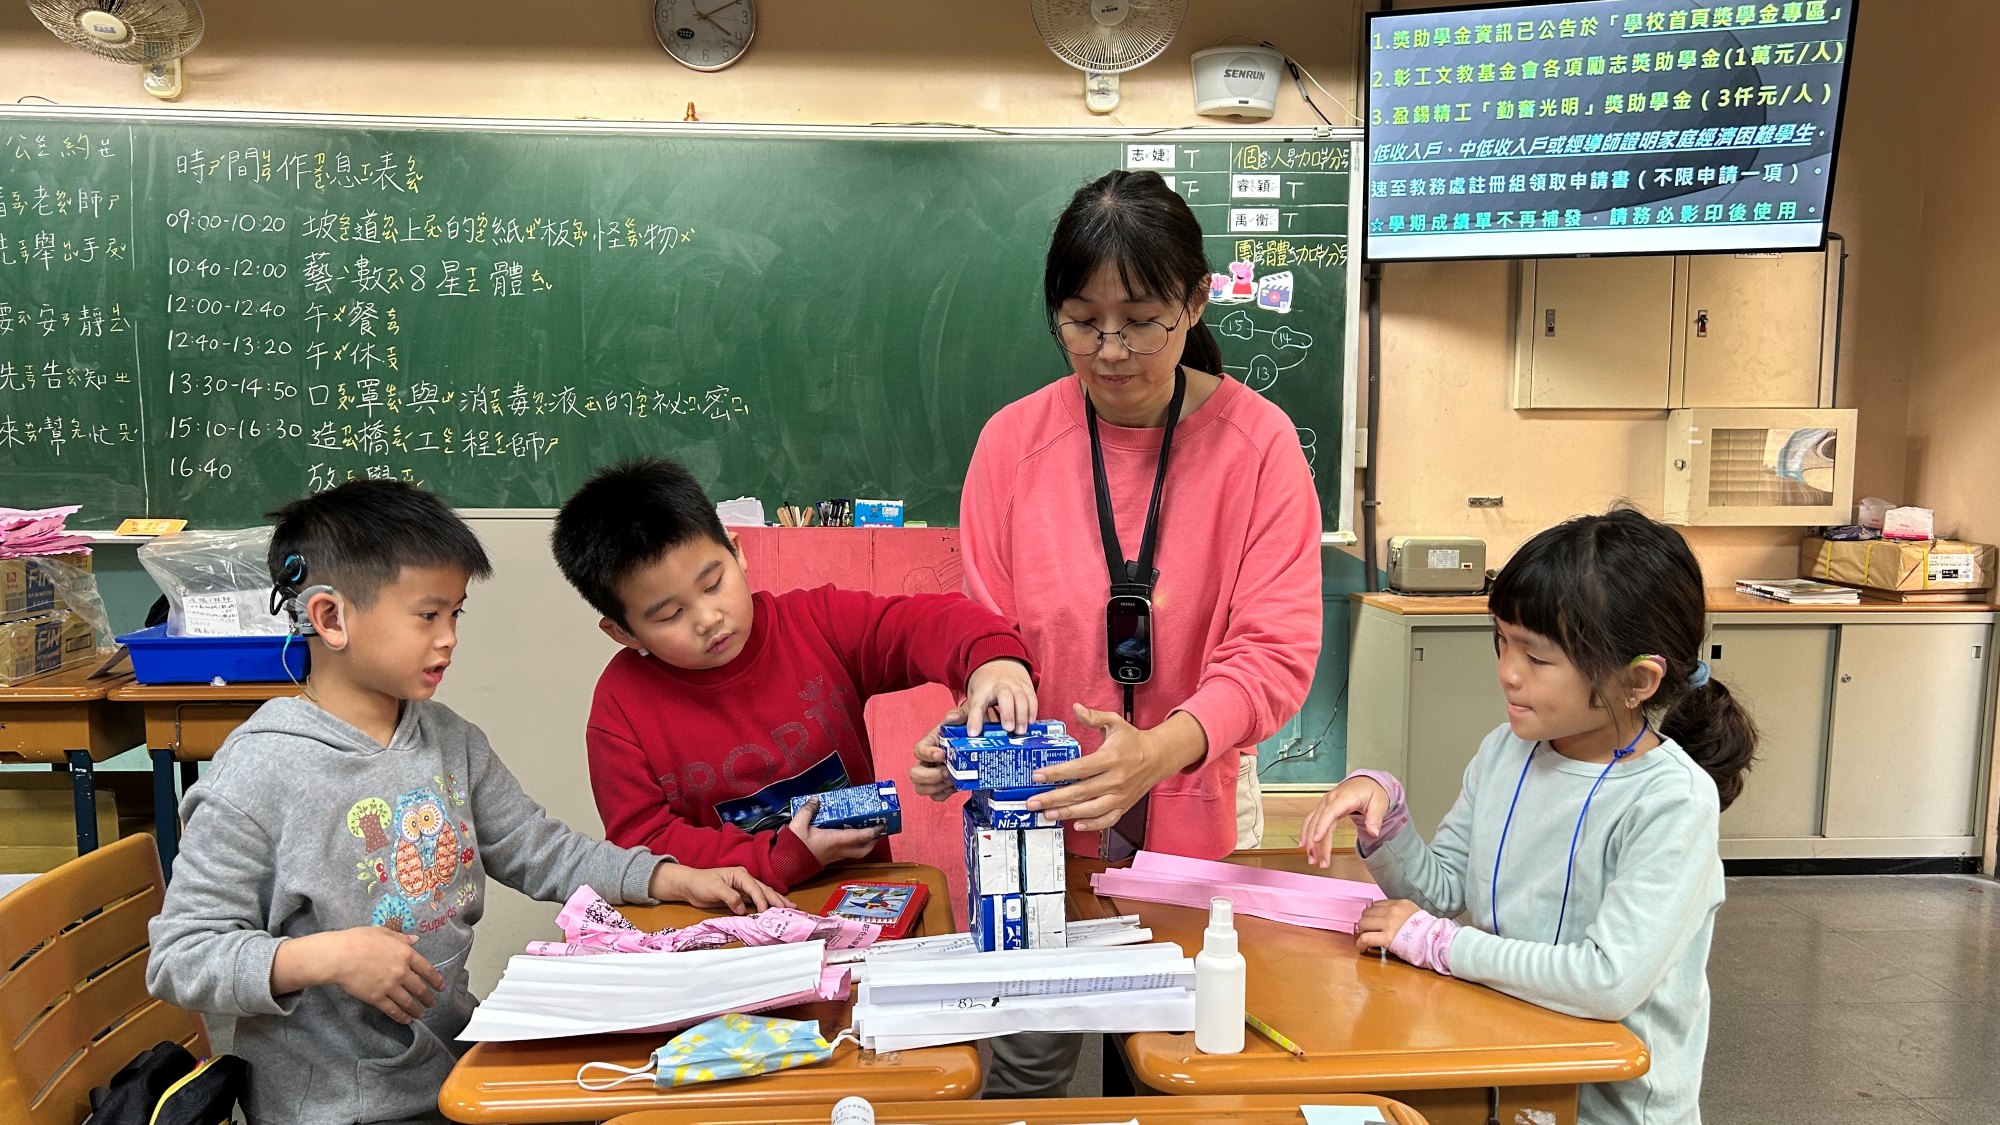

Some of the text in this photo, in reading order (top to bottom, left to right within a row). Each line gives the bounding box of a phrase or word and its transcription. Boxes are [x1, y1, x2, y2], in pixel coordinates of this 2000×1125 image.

[1223, 69, 1265, 80] SENRUN
[166, 208, 286, 234] 09:00-10:20
[168, 258, 287, 280] 10:40-12:00
[168, 295, 286, 317] 12:00-12:40
[1229, 319, 1244, 332] 15
[168, 330, 292, 355] 12:40-13:20
[1279, 332, 1292, 344] 14
[1256, 366, 1270, 381] 13
[169, 370, 298, 400] 13:30-14:50
[170, 417, 303, 443] 15:10-16:30
[171, 456, 232, 479] 16:40
[997, 818, 1018, 829] FIN
